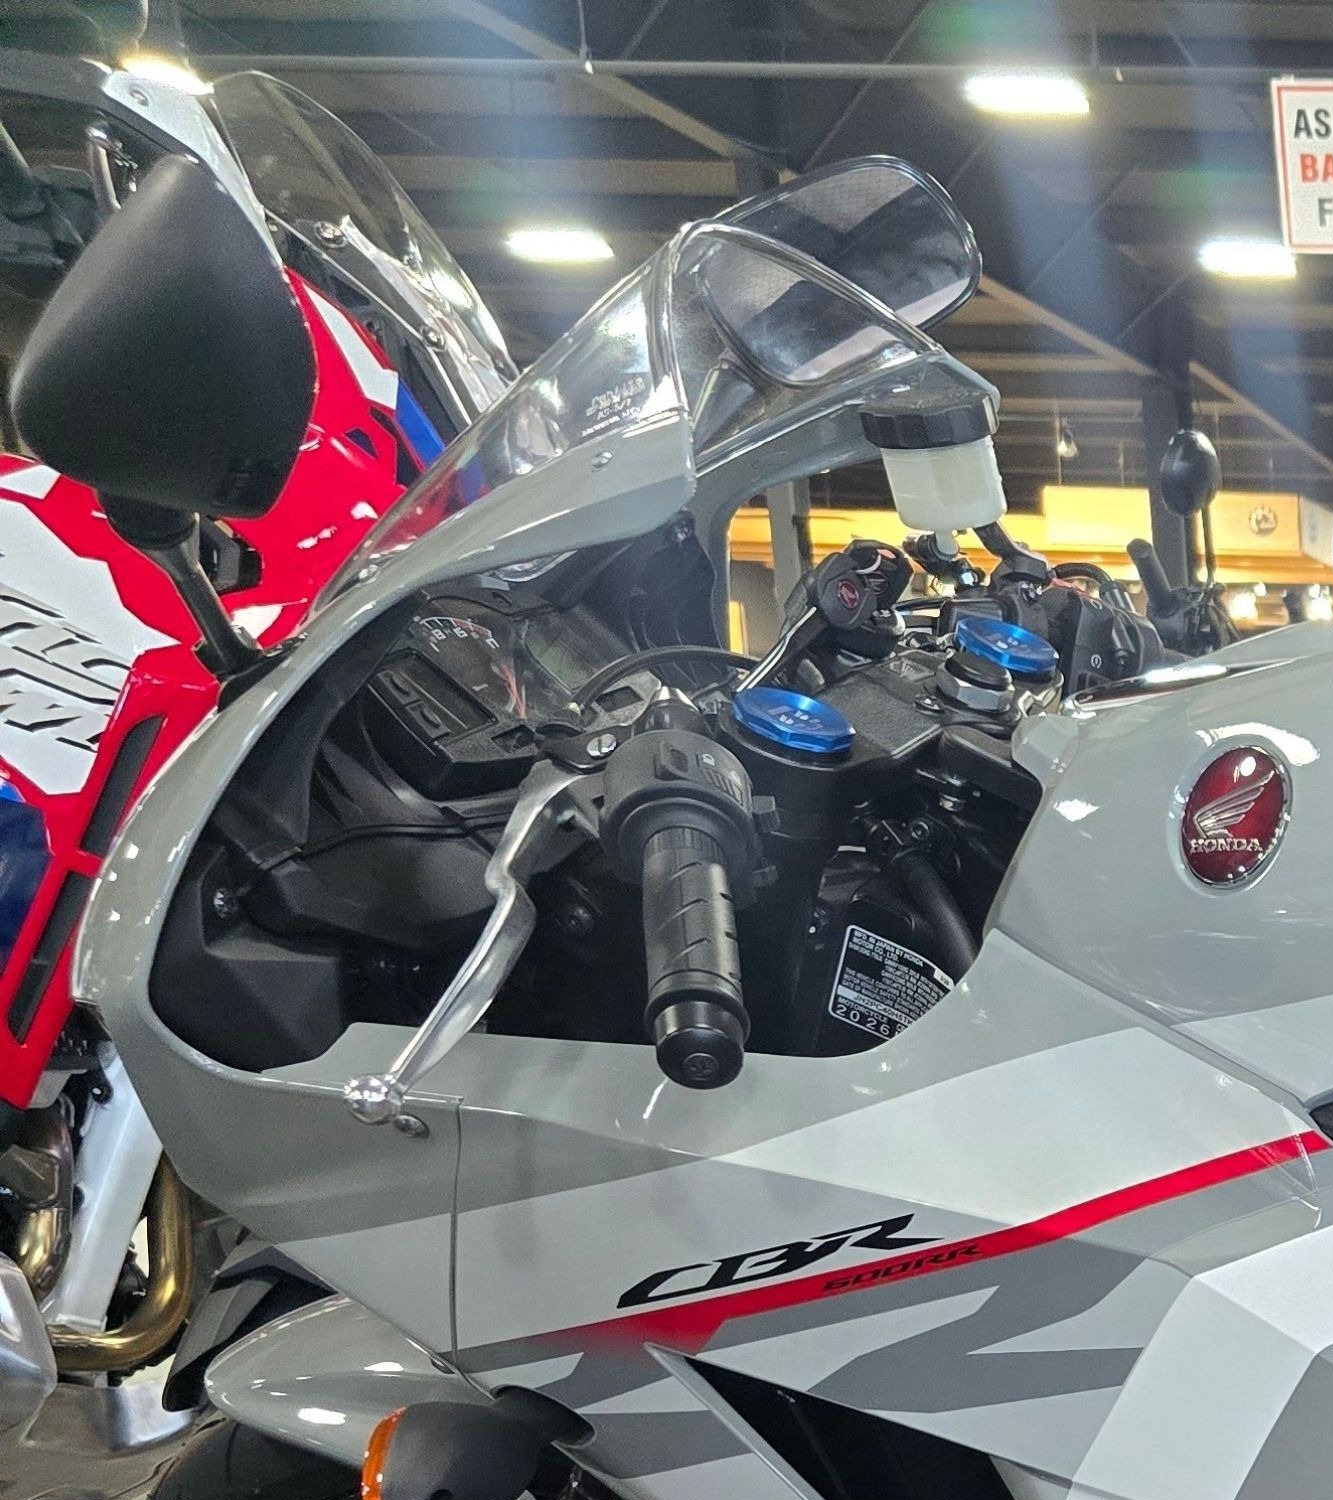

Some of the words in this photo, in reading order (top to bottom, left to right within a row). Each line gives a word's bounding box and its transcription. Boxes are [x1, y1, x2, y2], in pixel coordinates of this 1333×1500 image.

[1190, 837, 1264, 854] HONDA
[616, 1213, 945, 1309] CBR
[822, 1243, 981, 1293] 600RR
